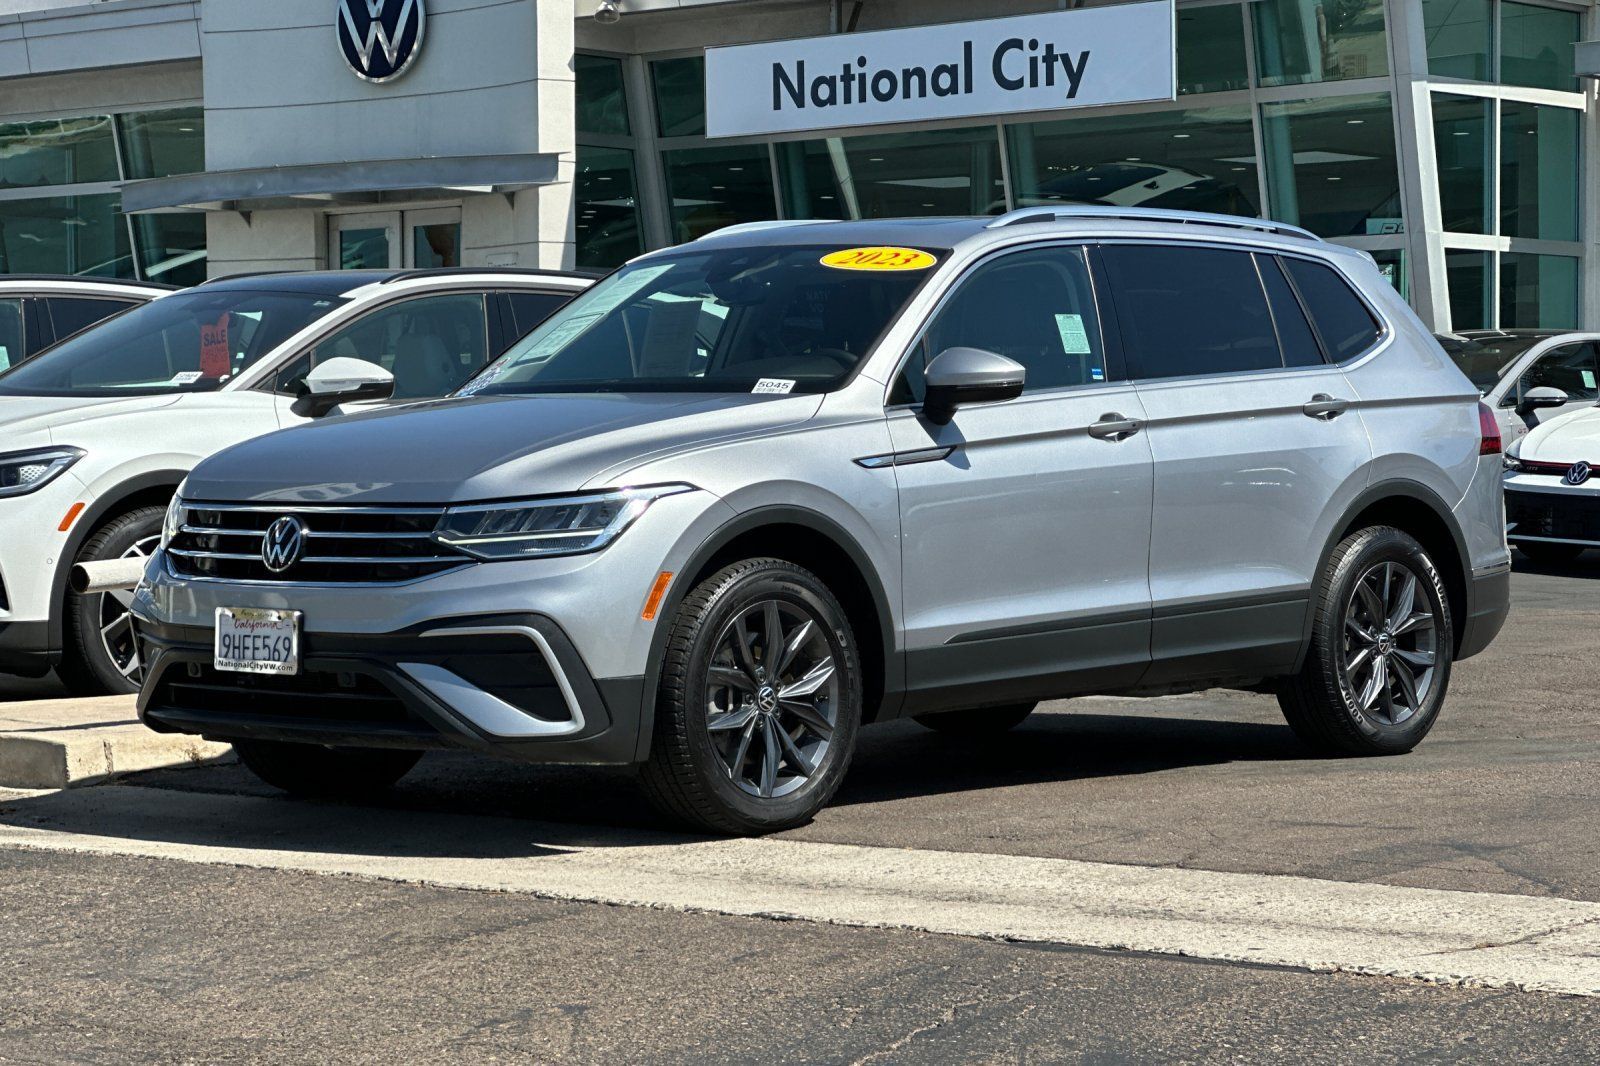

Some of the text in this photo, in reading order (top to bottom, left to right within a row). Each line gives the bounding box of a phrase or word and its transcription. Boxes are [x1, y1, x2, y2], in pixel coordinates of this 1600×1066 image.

[772, 37, 1091, 111] National City
[835, 251, 920, 266] 2023
[203, 329, 226, 347] SALE
[757, 381, 790, 389] 5045
[263, 517, 301, 571] VW
[234, 619, 281, 633] California
[222, 633, 291, 663] 9HFE569
[217, 660, 293, 672] NationalCityVW.com
